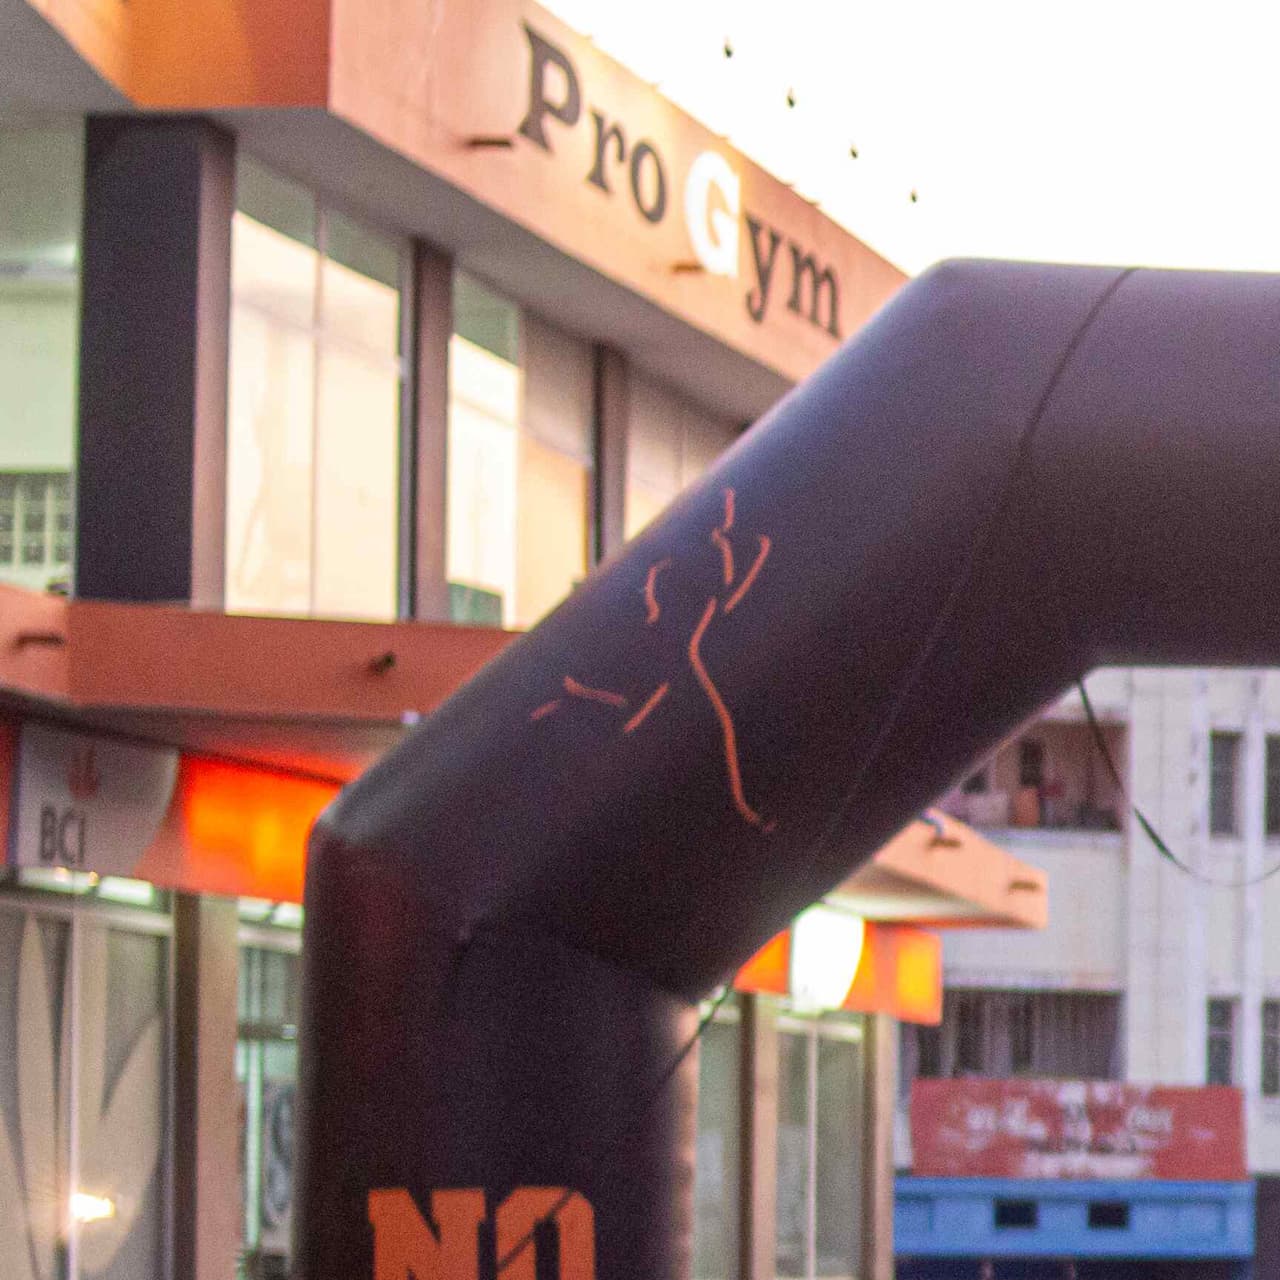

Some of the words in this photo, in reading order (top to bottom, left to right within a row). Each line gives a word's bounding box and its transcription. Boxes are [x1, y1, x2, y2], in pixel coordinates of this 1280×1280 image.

[518, 19, 668, 225] Pro
[684, 148, 845, 338] Gym
[40, 804, 86, 865] BCI
